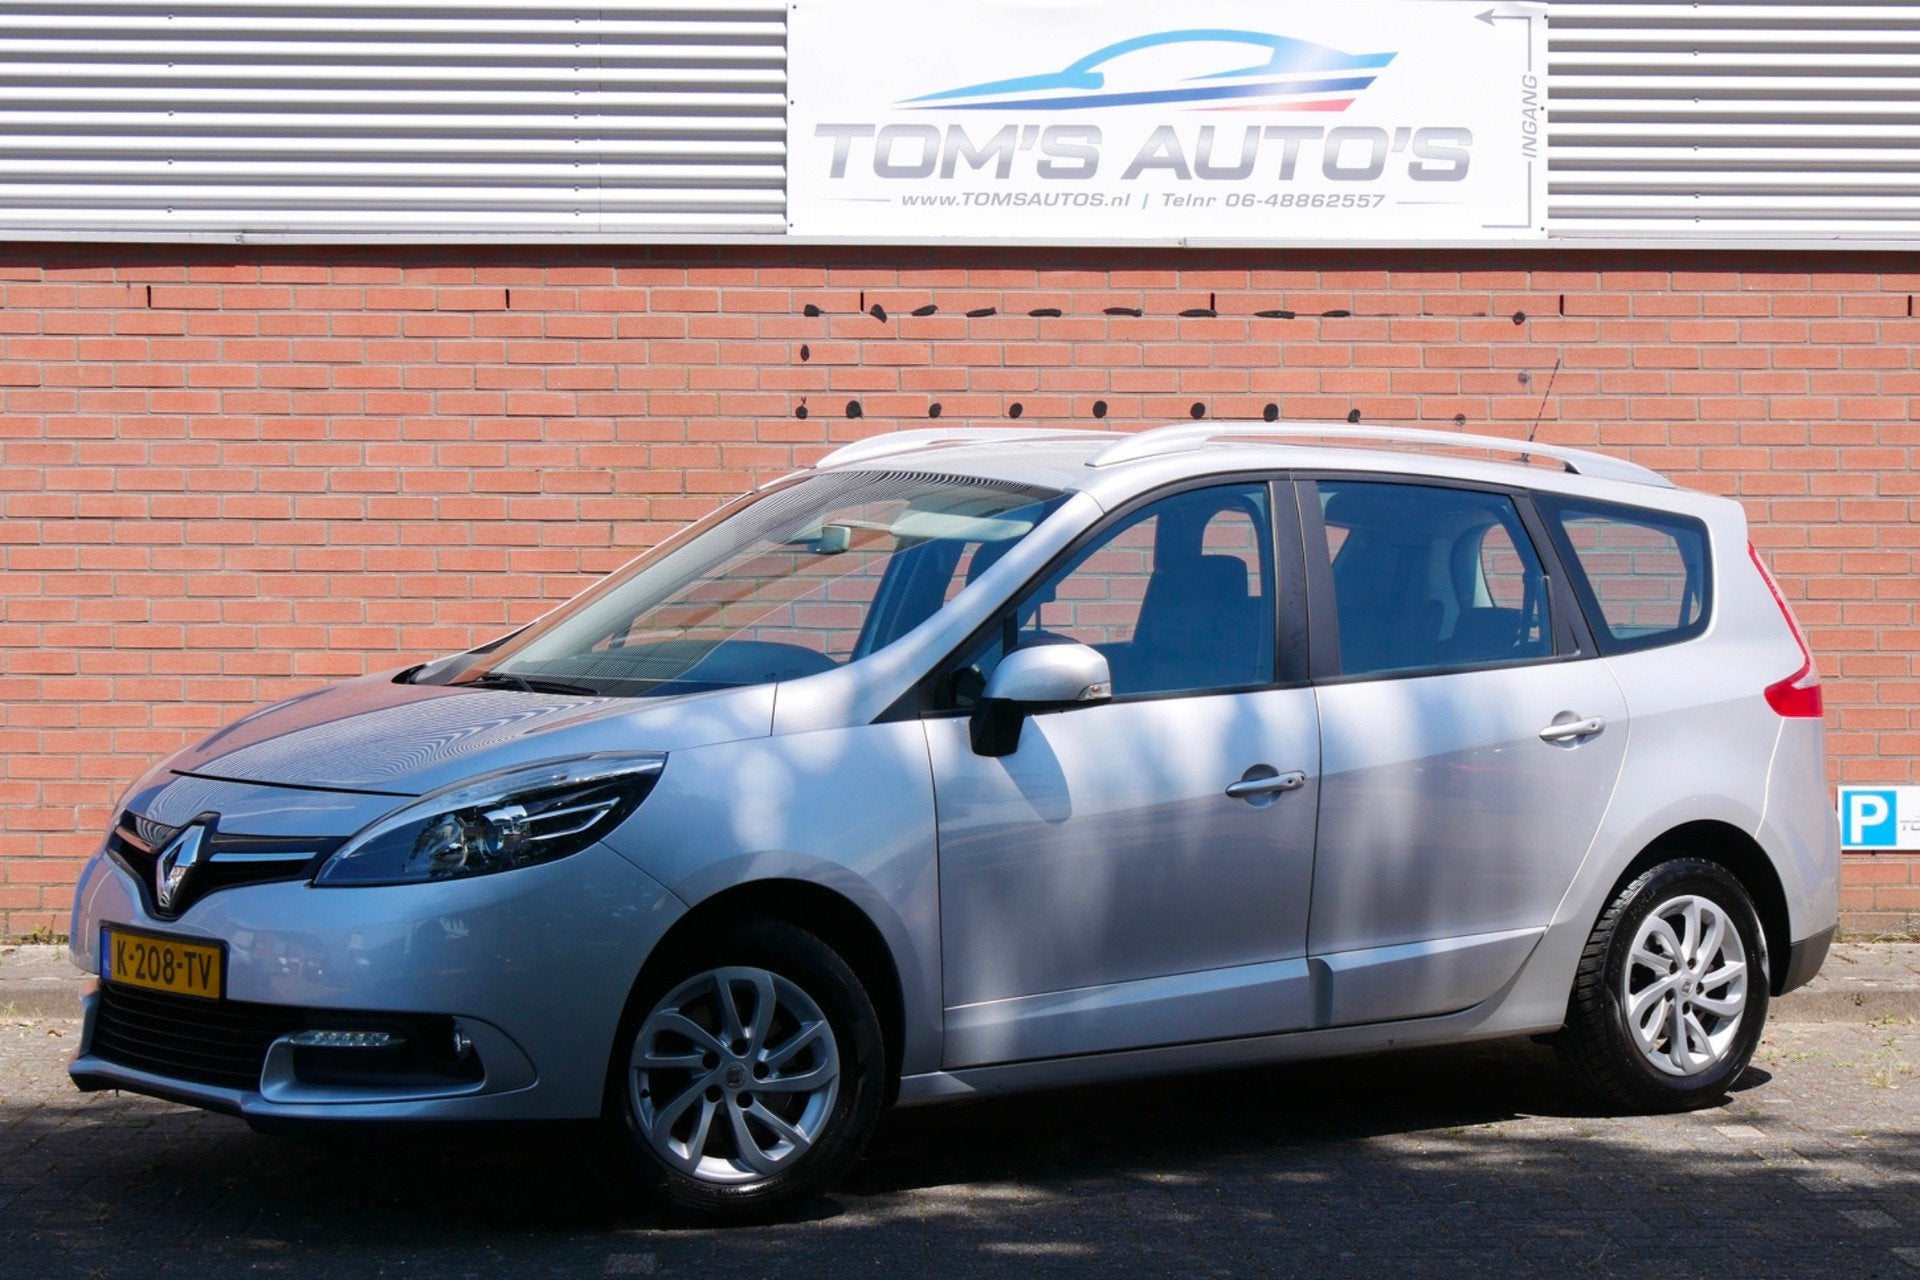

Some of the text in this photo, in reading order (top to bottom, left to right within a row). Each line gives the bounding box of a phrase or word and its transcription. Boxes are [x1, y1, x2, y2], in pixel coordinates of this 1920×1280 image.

[1522, 75, 1538, 158] INGANG
[814, 123, 1473, 182] TOM'S AUTO'S
[901, 192, 1386, 208] www.TOMSAUTOS.nl Telnr 06-48862557
[1850, 795, 1889, 844] P
[117, 940, 212, 990] K-208-TV
